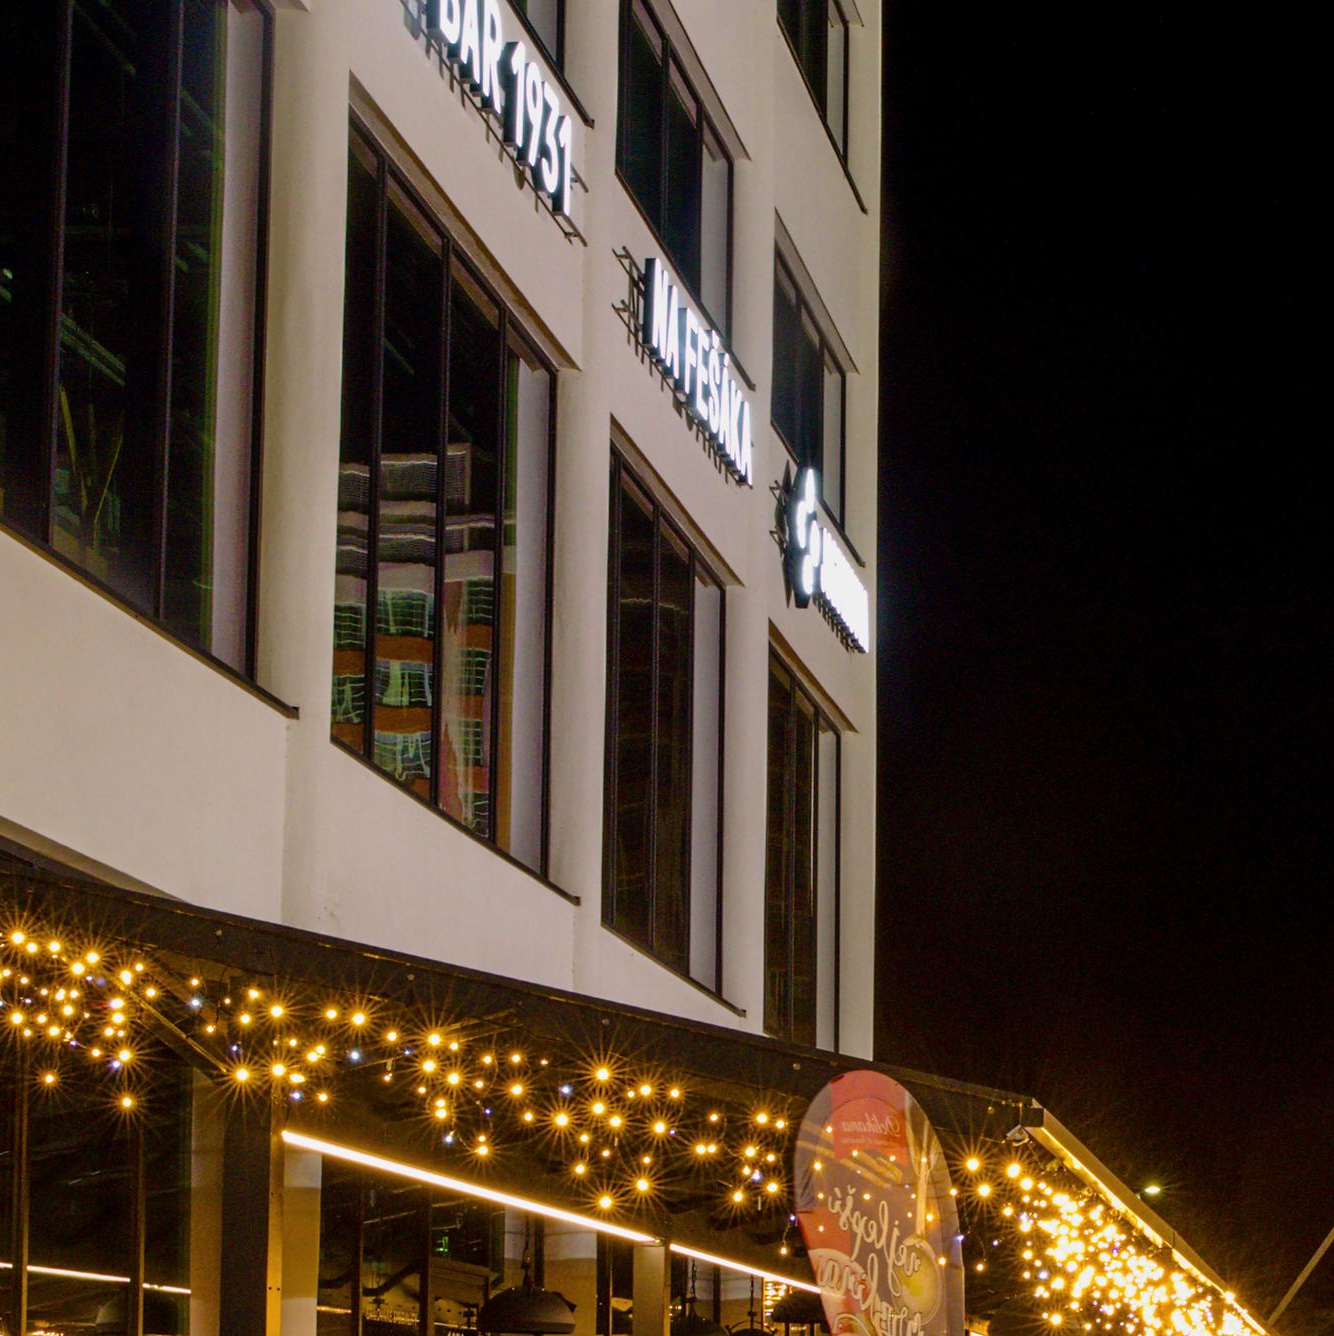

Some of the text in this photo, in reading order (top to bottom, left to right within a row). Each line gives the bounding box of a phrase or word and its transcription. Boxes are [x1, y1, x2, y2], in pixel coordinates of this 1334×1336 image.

[511, 40, 572, 217] 1931
[652, 257, 754, 485] NA FEŠÁKA
